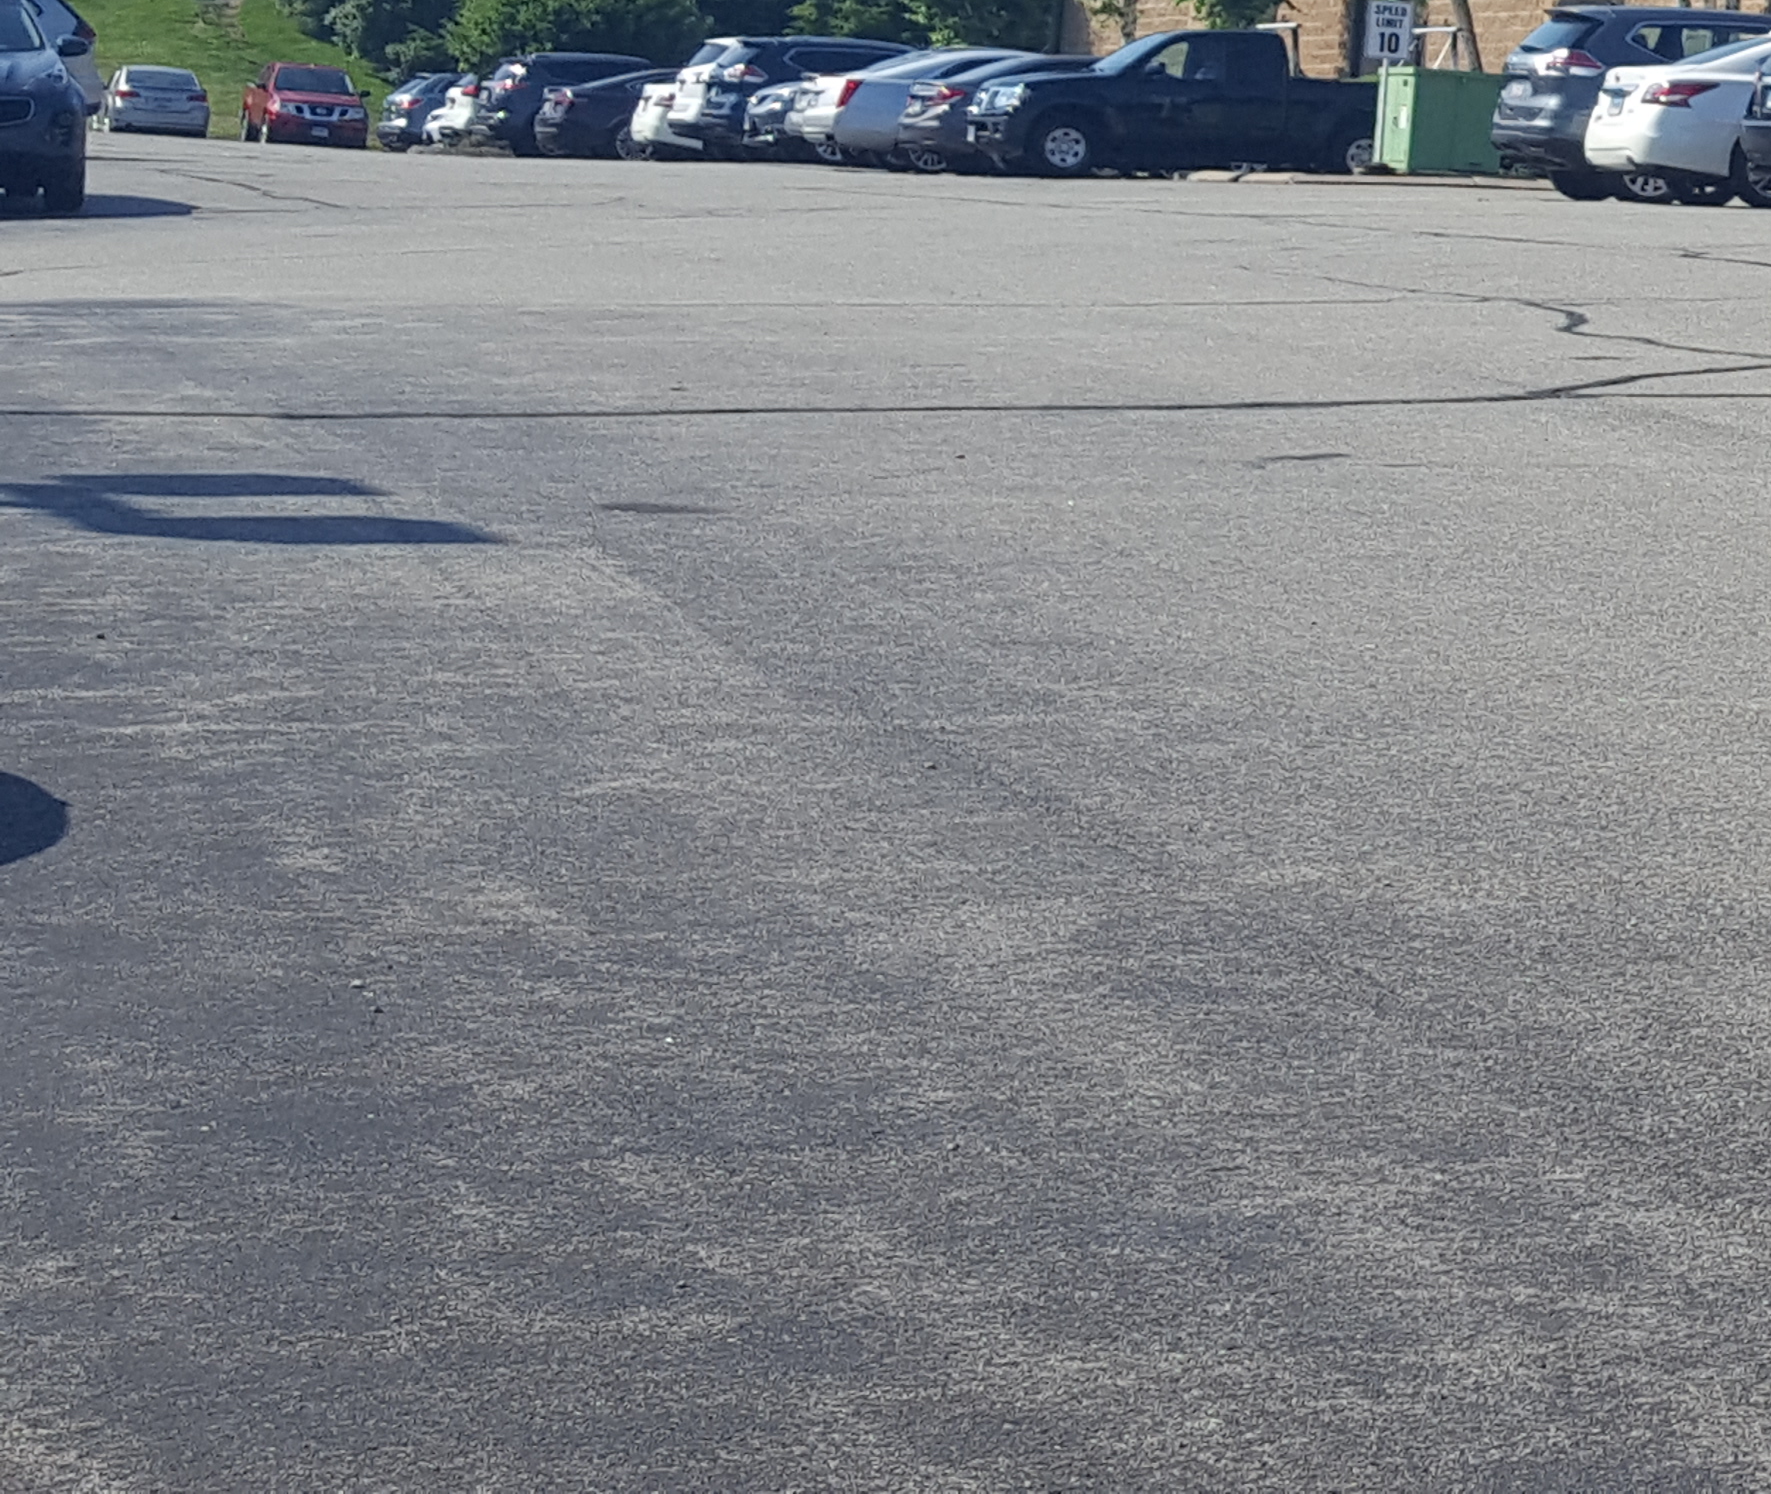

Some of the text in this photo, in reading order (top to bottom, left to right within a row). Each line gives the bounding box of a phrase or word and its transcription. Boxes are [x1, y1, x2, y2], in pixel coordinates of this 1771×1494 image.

[1375, 5, 1407, 17] SPEED
[1376, 17, 1403, 28] LIMIT
[1379, 32, 1400, 54] 10
